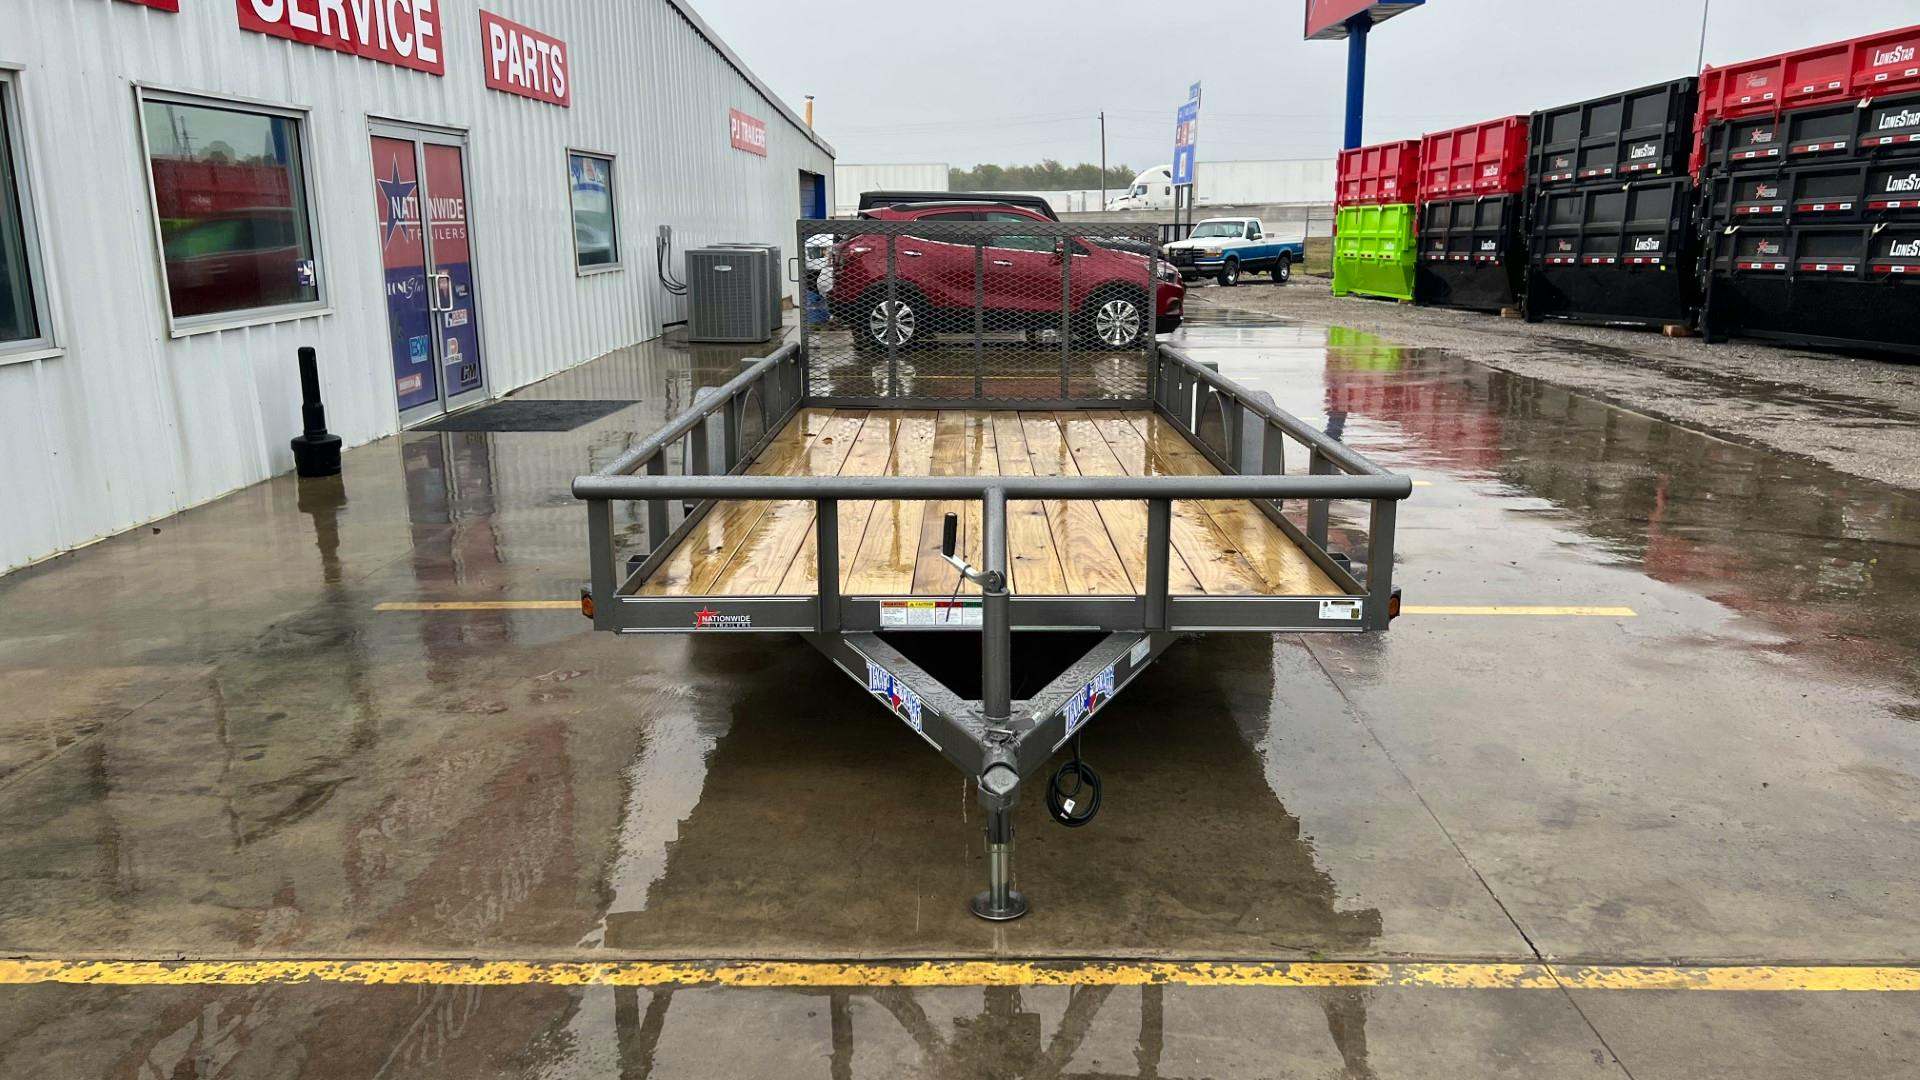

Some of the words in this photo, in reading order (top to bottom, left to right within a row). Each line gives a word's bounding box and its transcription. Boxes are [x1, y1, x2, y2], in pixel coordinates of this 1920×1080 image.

[251, 0, 438, 64] RVICE
[489, 22, 566, 98] PARTS
[731, 118, 740, 140] PJ
[391, 195, 465, 219] NATINWIDE
[408, 227, 466, 241] TRILERS
